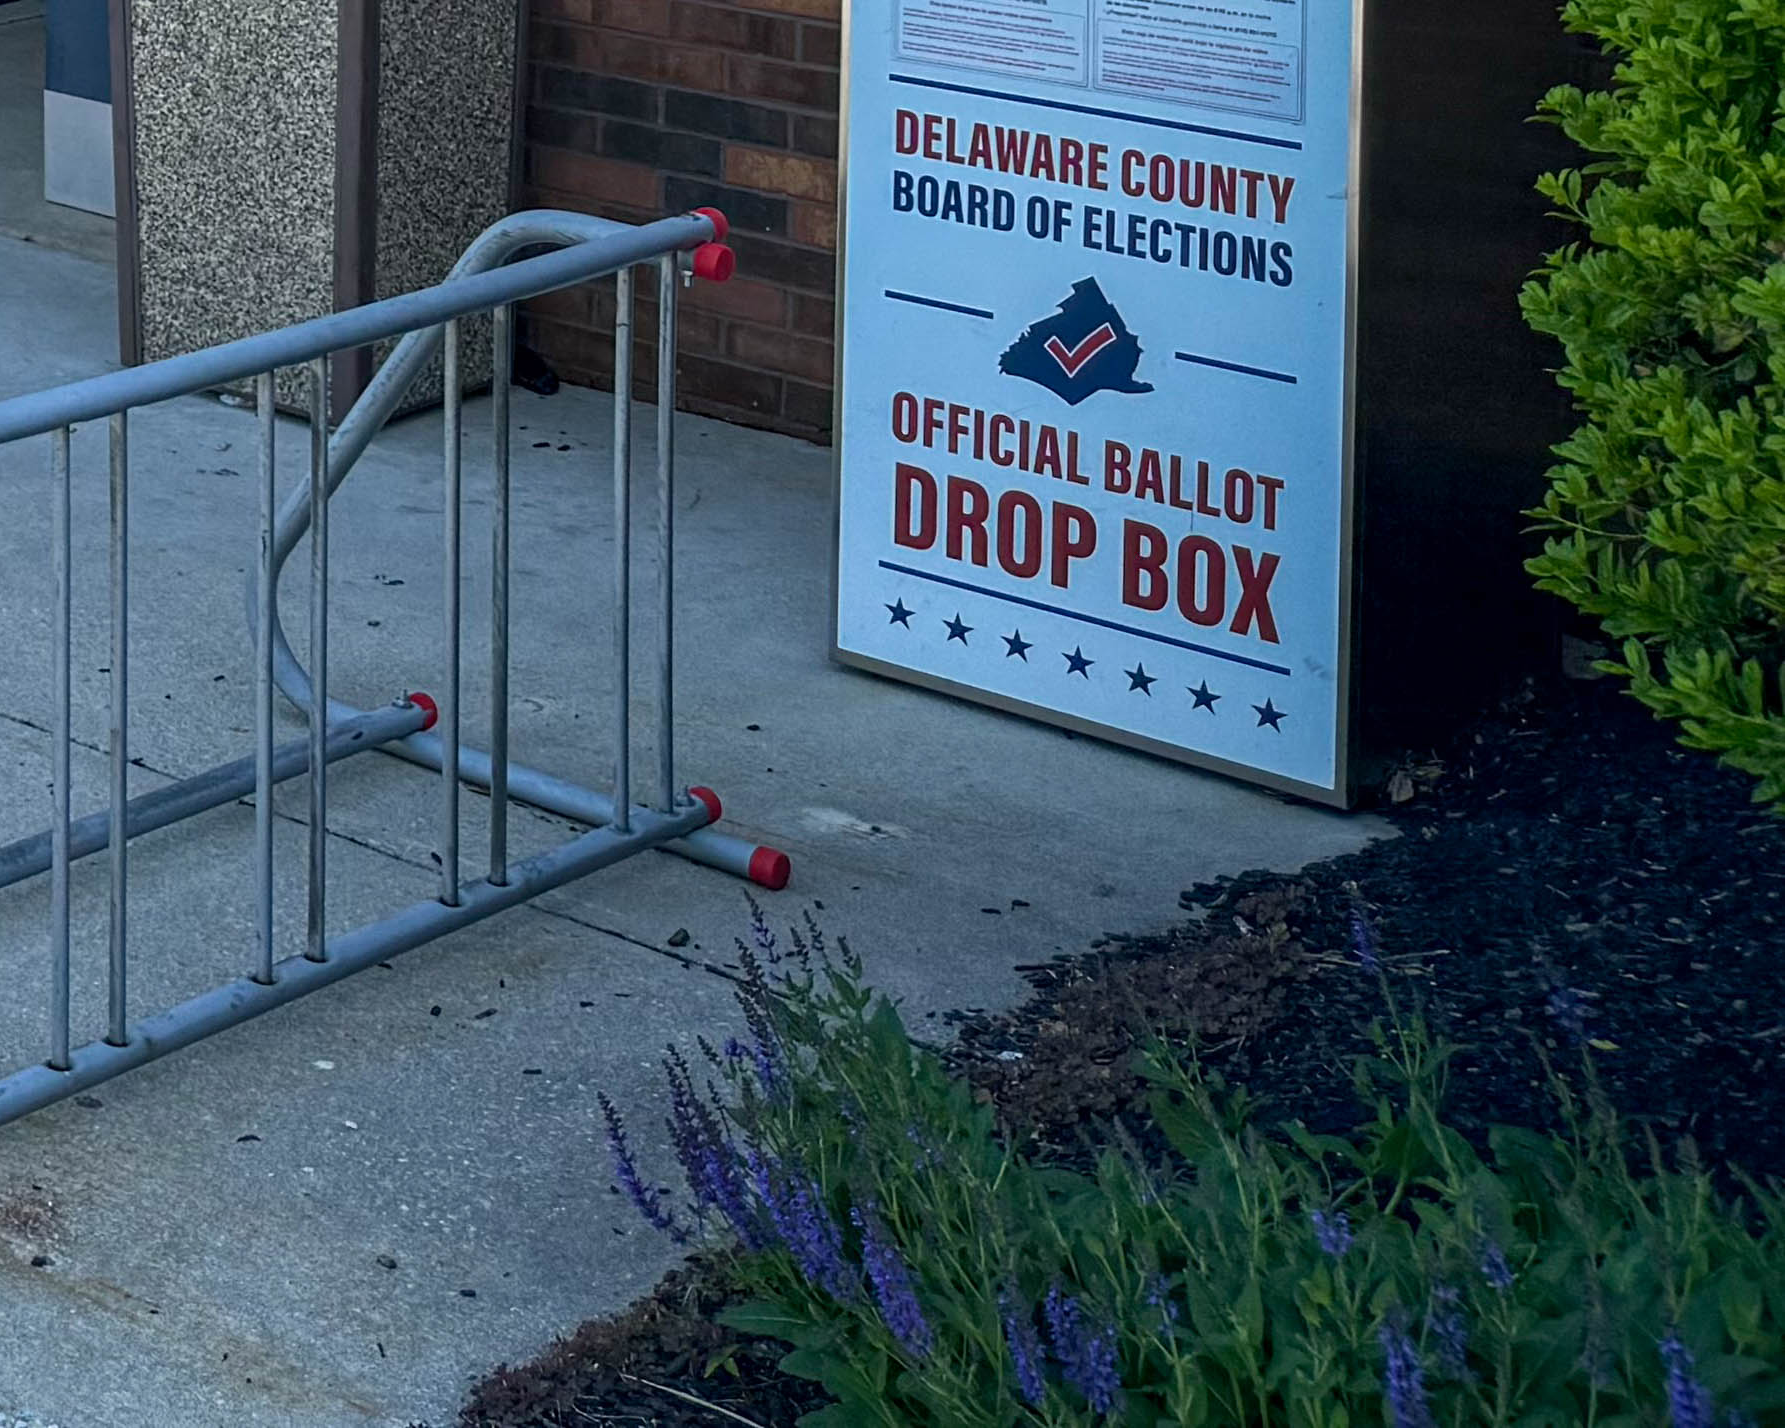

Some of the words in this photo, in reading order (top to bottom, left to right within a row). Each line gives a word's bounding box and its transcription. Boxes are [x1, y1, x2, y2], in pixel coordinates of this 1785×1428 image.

[892, 170, 1015, 232] BOARD
[1025, 194, 1074, 241] OF
[1082, 205, 1294, 288] ELECTIONS
[894, 109, 1109, 192] DELAWARE
[1121, 147, 1296, 224] COUNTY
[892, 391, 1089, 487] OFFICIAL
[1104, 439, 1285, 531] BALLOT
[893, 462, 1098, 590] DROP
[1122, 519, 1281, 645] BOX
